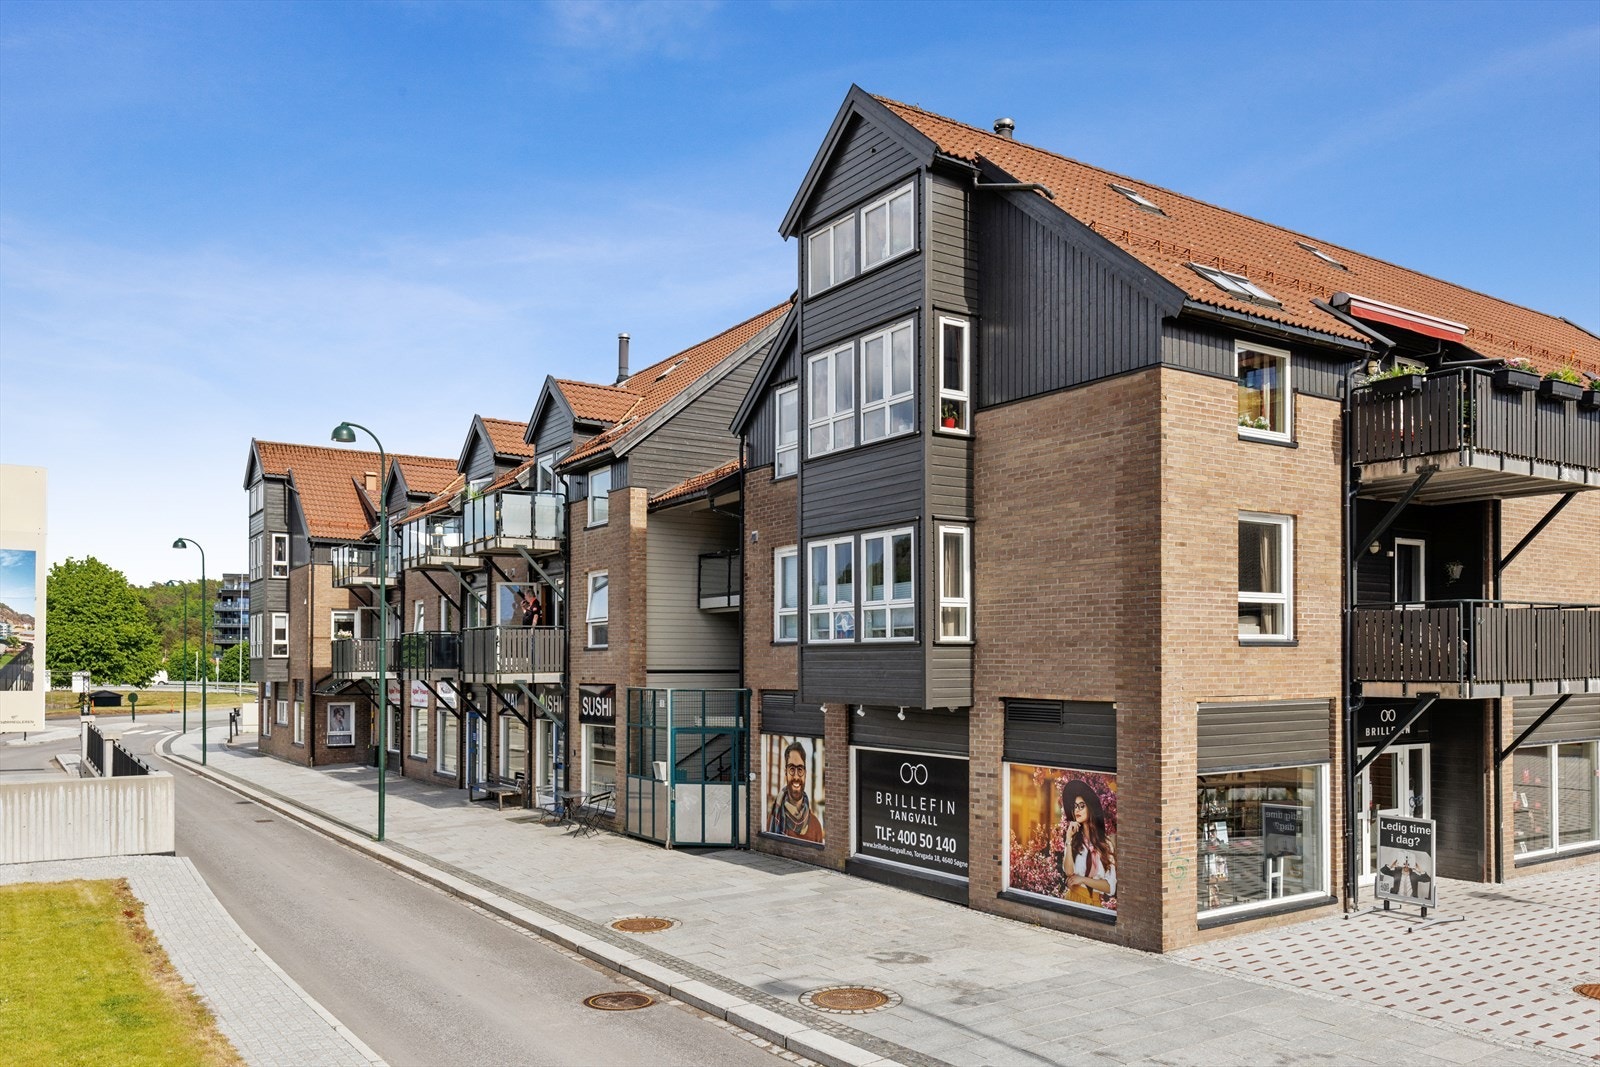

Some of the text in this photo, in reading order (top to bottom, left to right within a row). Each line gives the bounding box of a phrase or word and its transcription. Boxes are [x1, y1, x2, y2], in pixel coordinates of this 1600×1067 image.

[582, 696, 613, 717] SUSHI
[1365, 726, 1411, 737] BRILLN
[876, 791, 955, 815] BRILLEFIN
[890, 810, 938, 826] TANGVALL
[1381, 820, 1431, 835] Ledig time
[875, 825, 956, 853] TLF: 400 50 140
[1390, 833, 1420, 847] i dag?
